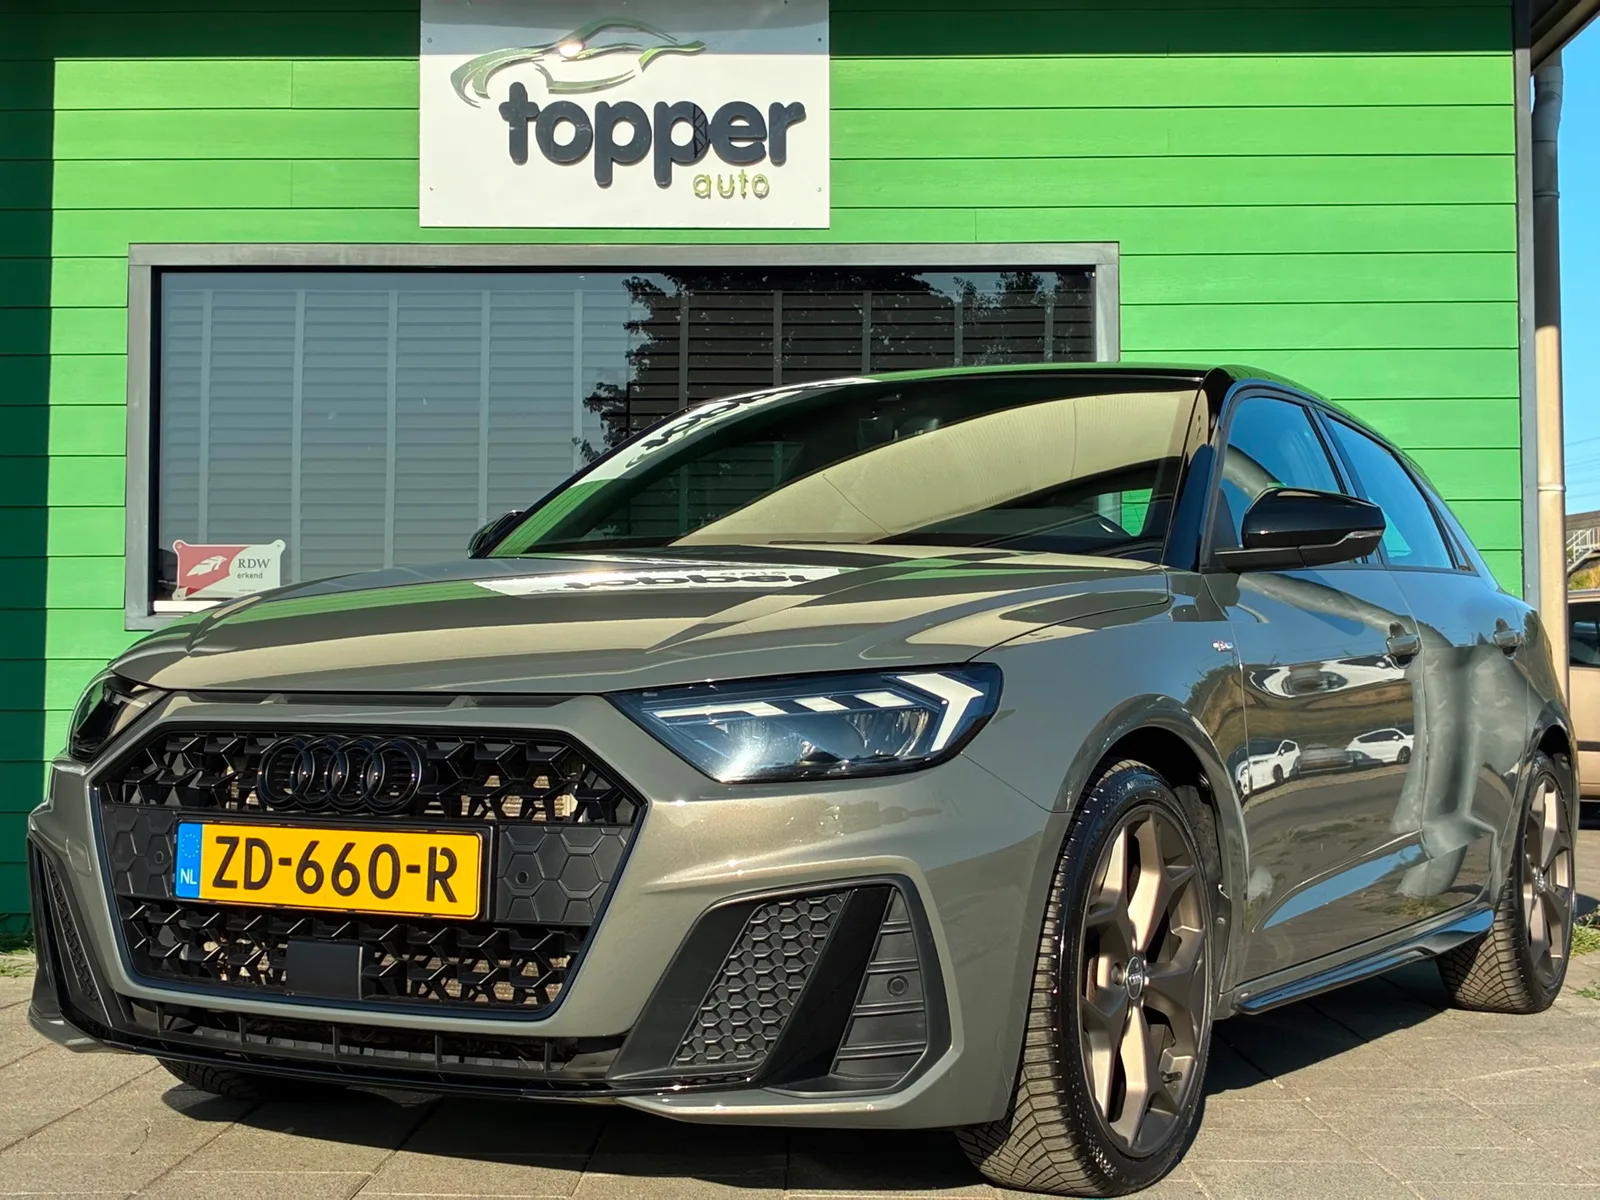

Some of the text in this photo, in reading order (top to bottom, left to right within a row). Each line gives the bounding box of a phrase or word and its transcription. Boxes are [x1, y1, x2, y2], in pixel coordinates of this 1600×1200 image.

[498, 81, 807, 188] topper
[693, 170, 770, 199] auto
[237, 571, 263, 579] erkend
[238, 558, 271, 569] RDW
[179, 867, 198, 885] NL
[211, 835, 458, 903] ZD-660-R
